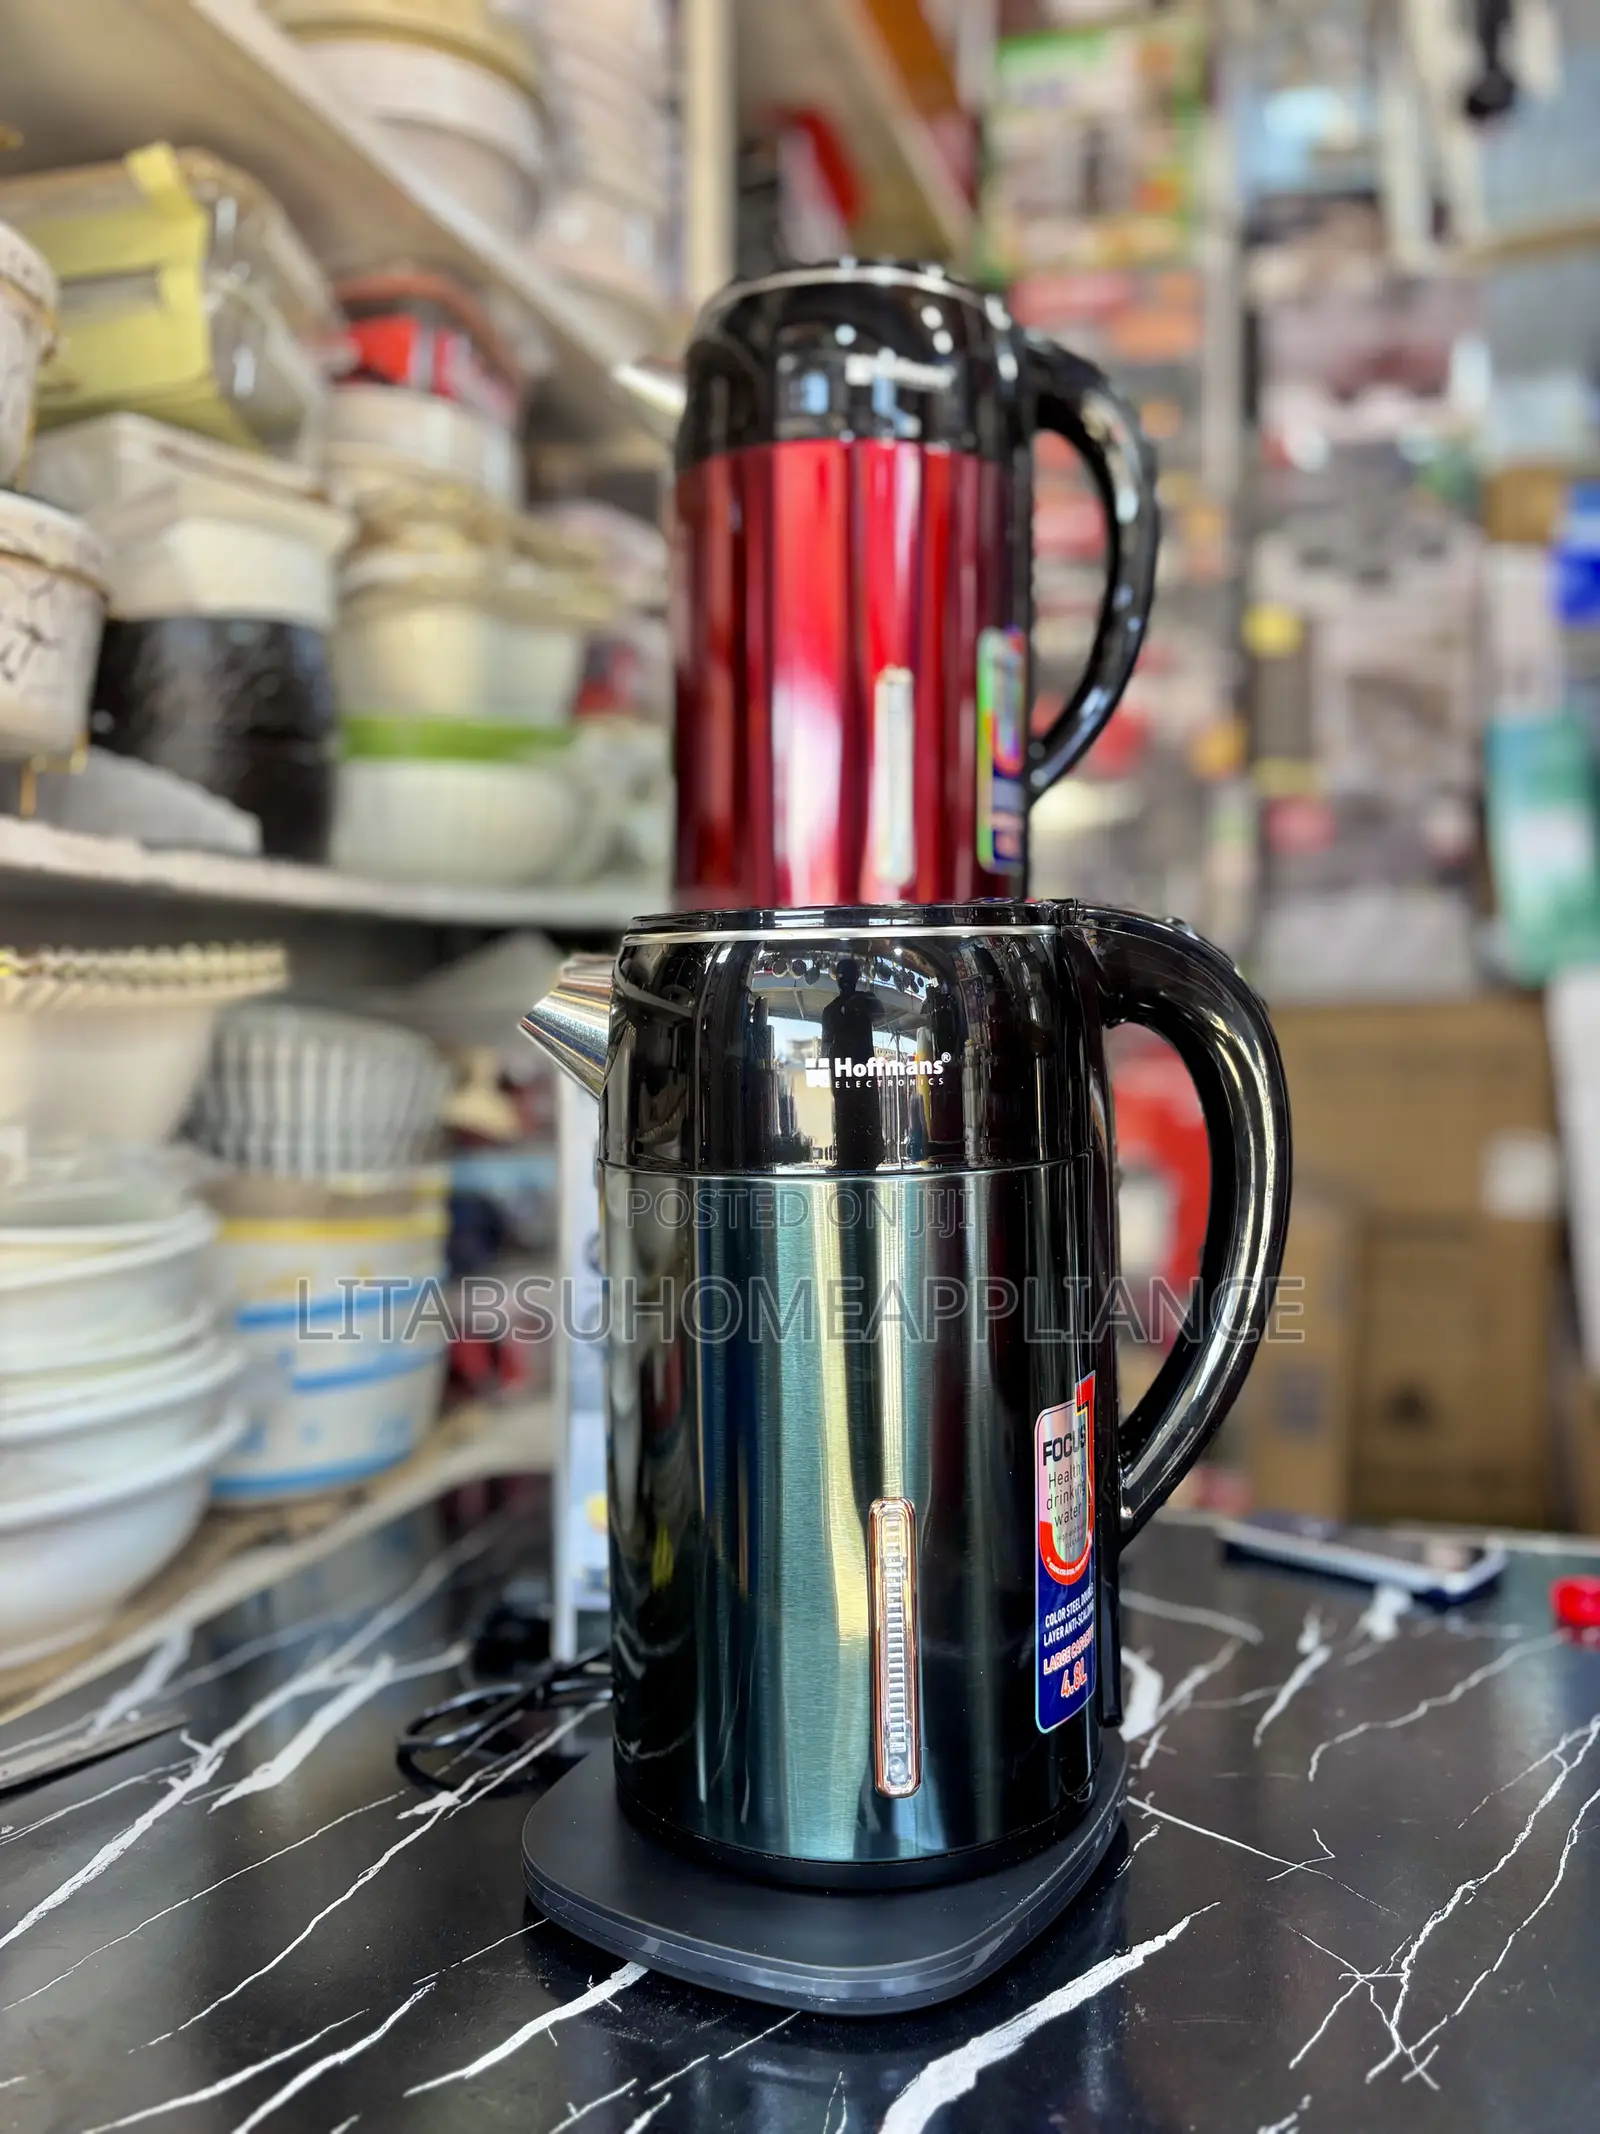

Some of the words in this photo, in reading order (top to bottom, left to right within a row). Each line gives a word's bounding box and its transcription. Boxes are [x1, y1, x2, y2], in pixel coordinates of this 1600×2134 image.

[835, 1077, 944, 1088] ELECTRONICS
[1043, 1424, 1086, 1466] FOCUS
[1048, 1459, 1085, 1489] Healthy
[1046, 1479, 1085, 1511] drinking
[1054, 1502, 1081, 1527] water
[1045, 1607, 1066, 1629] COLOR
[1066, 1596, 1081, 1618] STEEL
[1043, 1625, 1065, 1647] LAYER
[1043, 1645, 1071, 1676] LARGE
[1060, 1656, 1088, 1698] 4.8L
